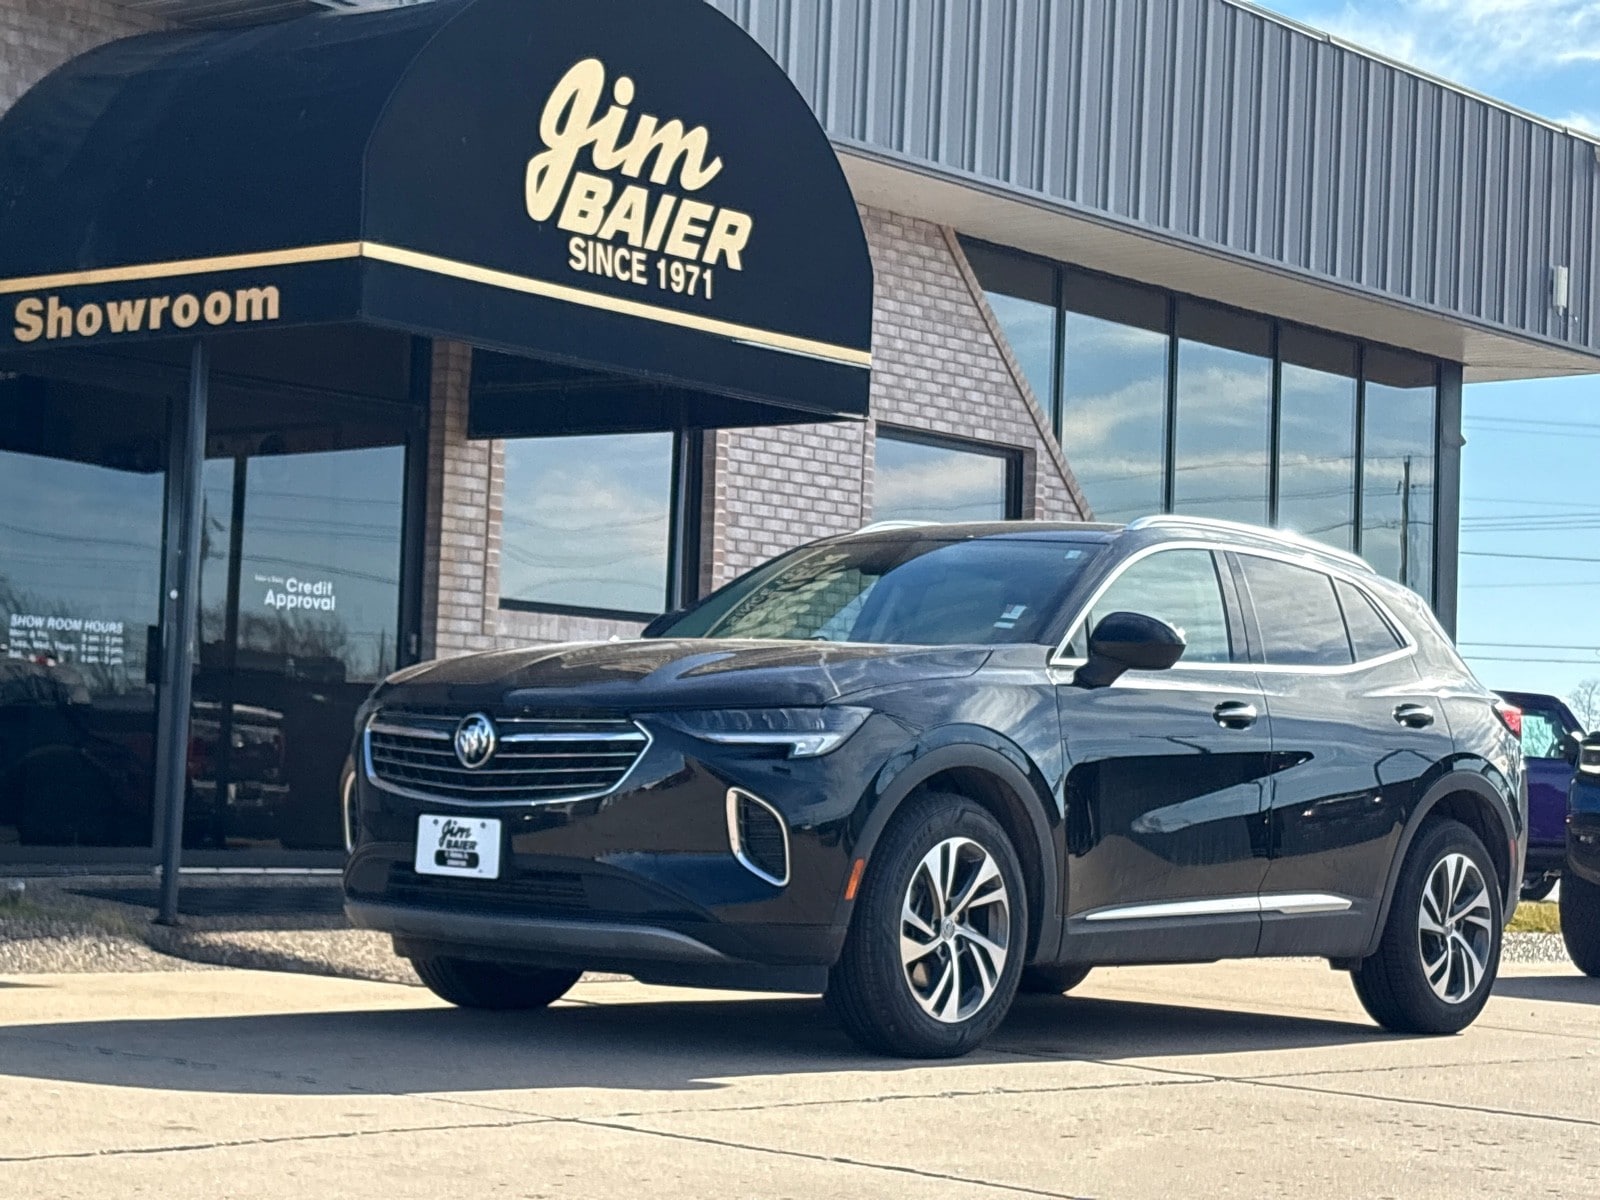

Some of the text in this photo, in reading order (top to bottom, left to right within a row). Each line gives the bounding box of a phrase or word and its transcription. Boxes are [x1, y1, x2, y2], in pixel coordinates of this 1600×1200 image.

[525, 58, 723, 222] Jim
[557, 171, 753, 271] BAIER
[568, 236, 713, 300] SINCE 1971
[14, 285, 280, 342] Showroom
[264, 589, 336, 611] Approval
[286, 577, 332, 596] Credit
[10, 613, 124, 634] SHOW ROOM HOURS
[439, 819, 472, 847] Jim
[446, 839, 477, 850] BAIER
